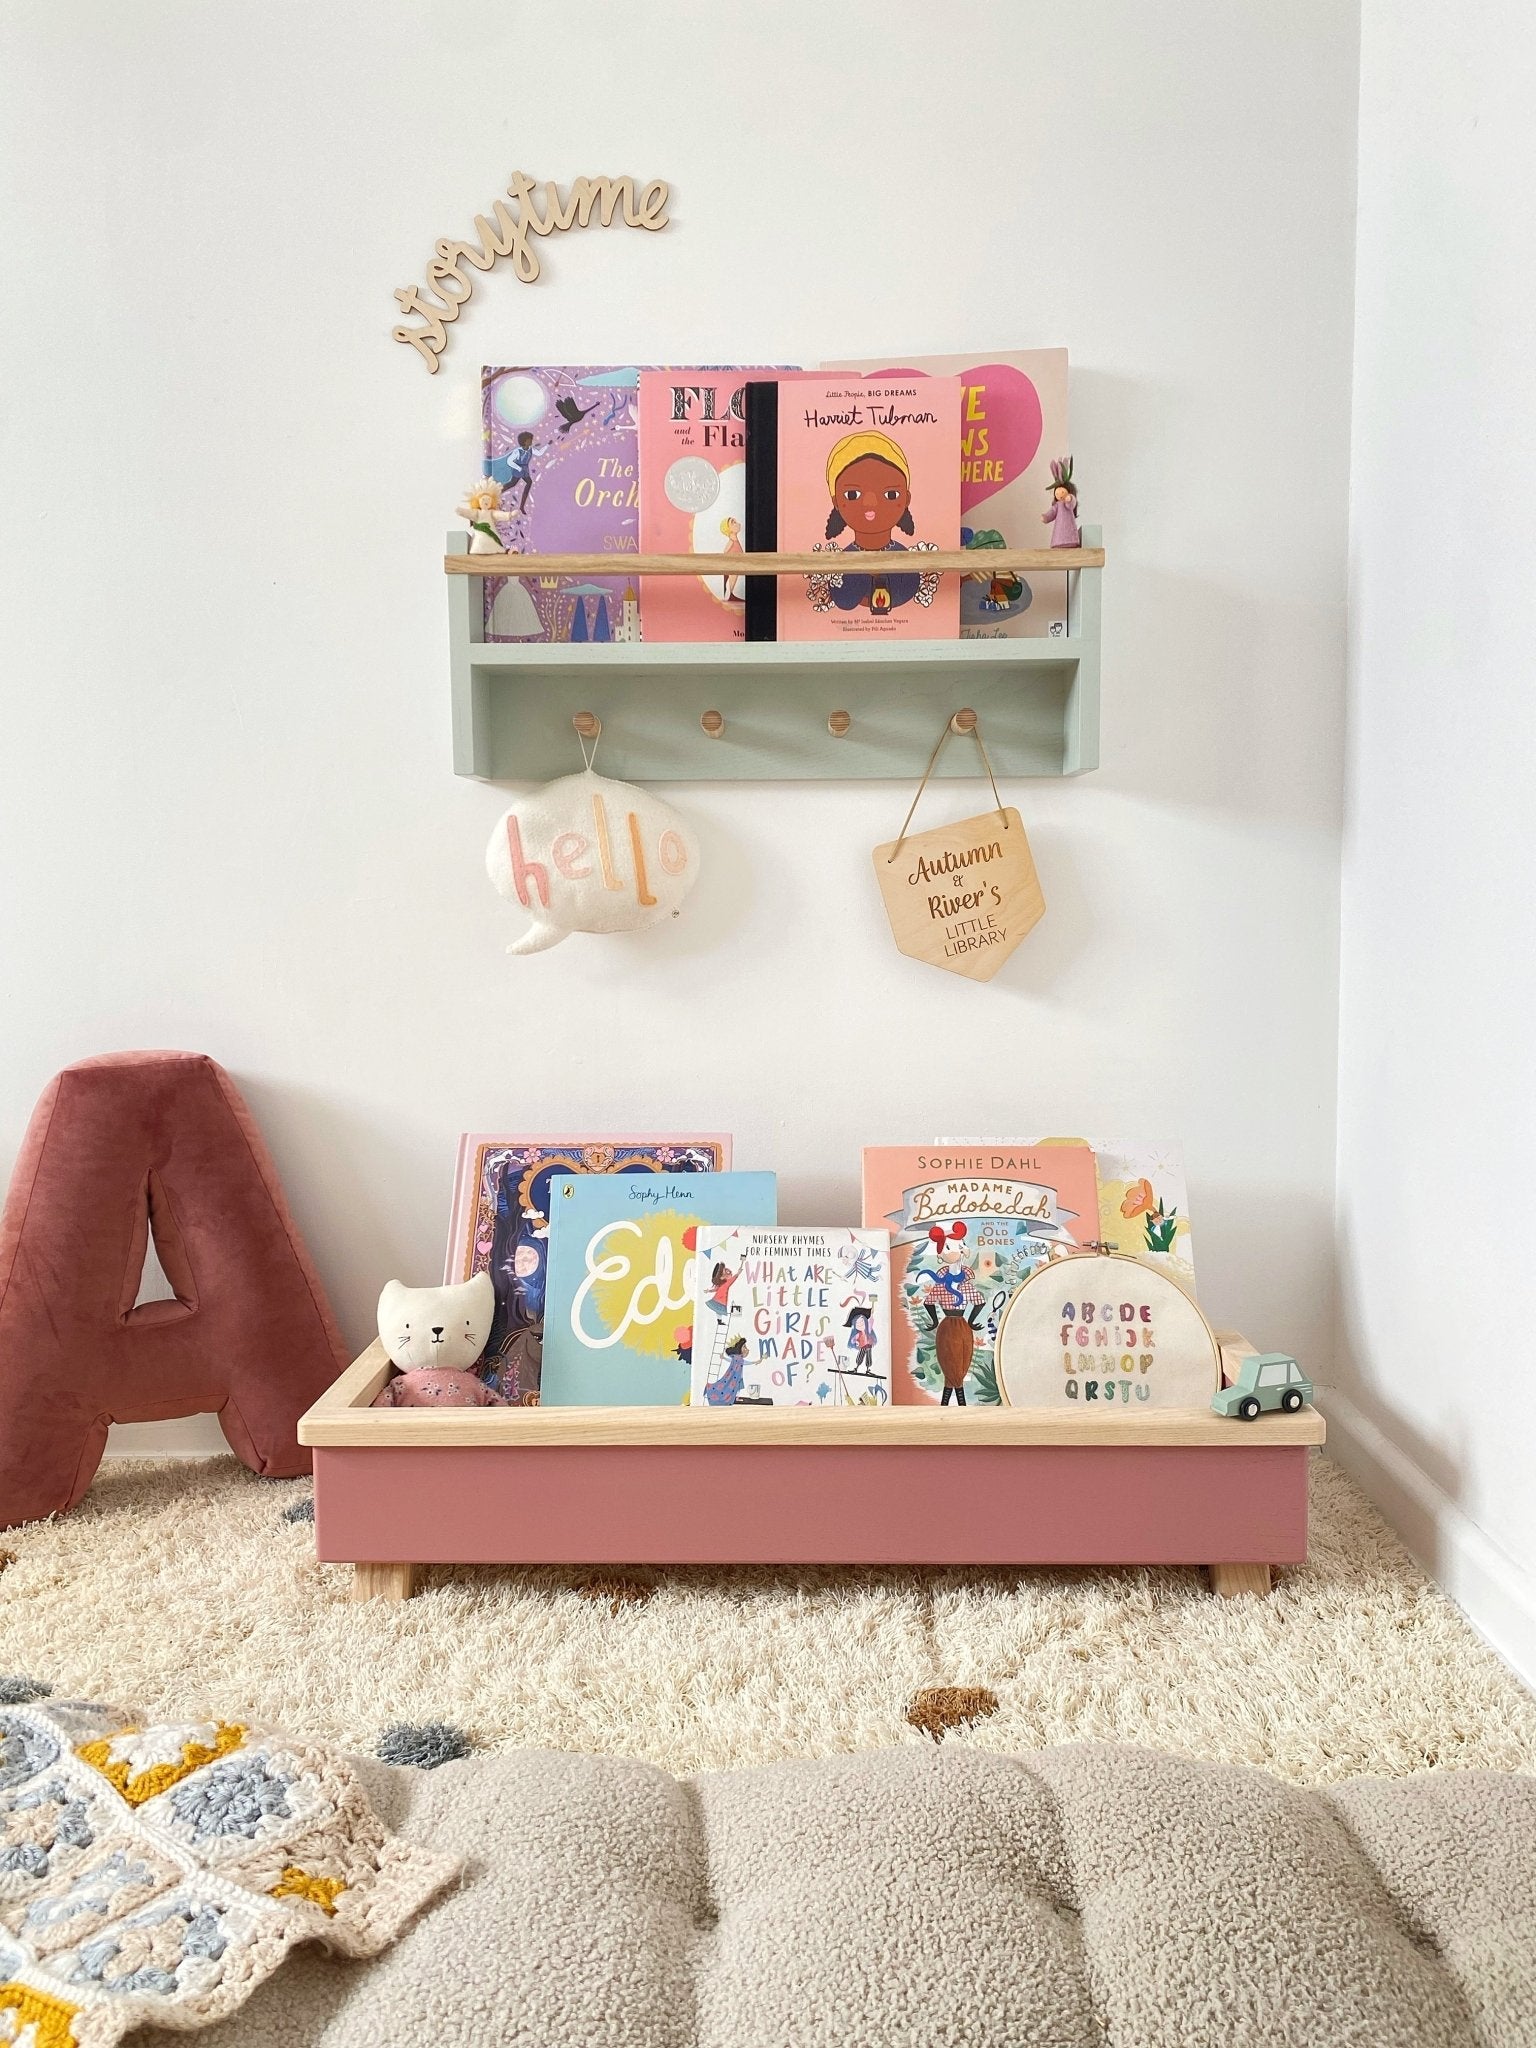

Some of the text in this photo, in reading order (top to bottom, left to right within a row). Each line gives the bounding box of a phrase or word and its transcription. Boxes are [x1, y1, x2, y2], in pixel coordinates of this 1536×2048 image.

[391, 169, 670, 375] storytime
[825, 390, 842, 398] Little
[867, 389, 882, 397] BIG
[884, 389, 917, 397] DREAMS
[804, 404, 938, 427] Harriet Tubman
[674, 426, 691, 435] and
[681, 437, 695, 445] the
[703, 425, 745, 447] Fla
[597, 457, 634, 478] The
[961, 460, 1004, 483] HERE
[575, 478, 639, 508] Orch
[603, 535, 638, 550] SWA
[506, 794, 689, 910] hello
[908, 842, 1004, 886] Autumn
[952, 874, 964, 887] &
[927, 881, 1002, 919] River's
[945, 914, 998, 940] LITTLE
[944, 928, 1007, 957] LIBRARY
[918, 1156, 1041, 1169] SOPHIE DAHL
[628, 1184, 695, 1205] Sophy Henn
[947, 1182, 1013, 1195] MADAME
[912, 1187, 1051, 1222] Badobedah
[752, 1235, 825, 1245] NURSERY RHYMES
[977, 1236, 1015, 1246] BONES
[983, 1226, 1009, 1237] OLD
[745, 1247, 832, 1258] FOR FEMINIST TIMES
[804, 1263, 833, 1285] ARE
[0, 1049, 348, 1530] A
